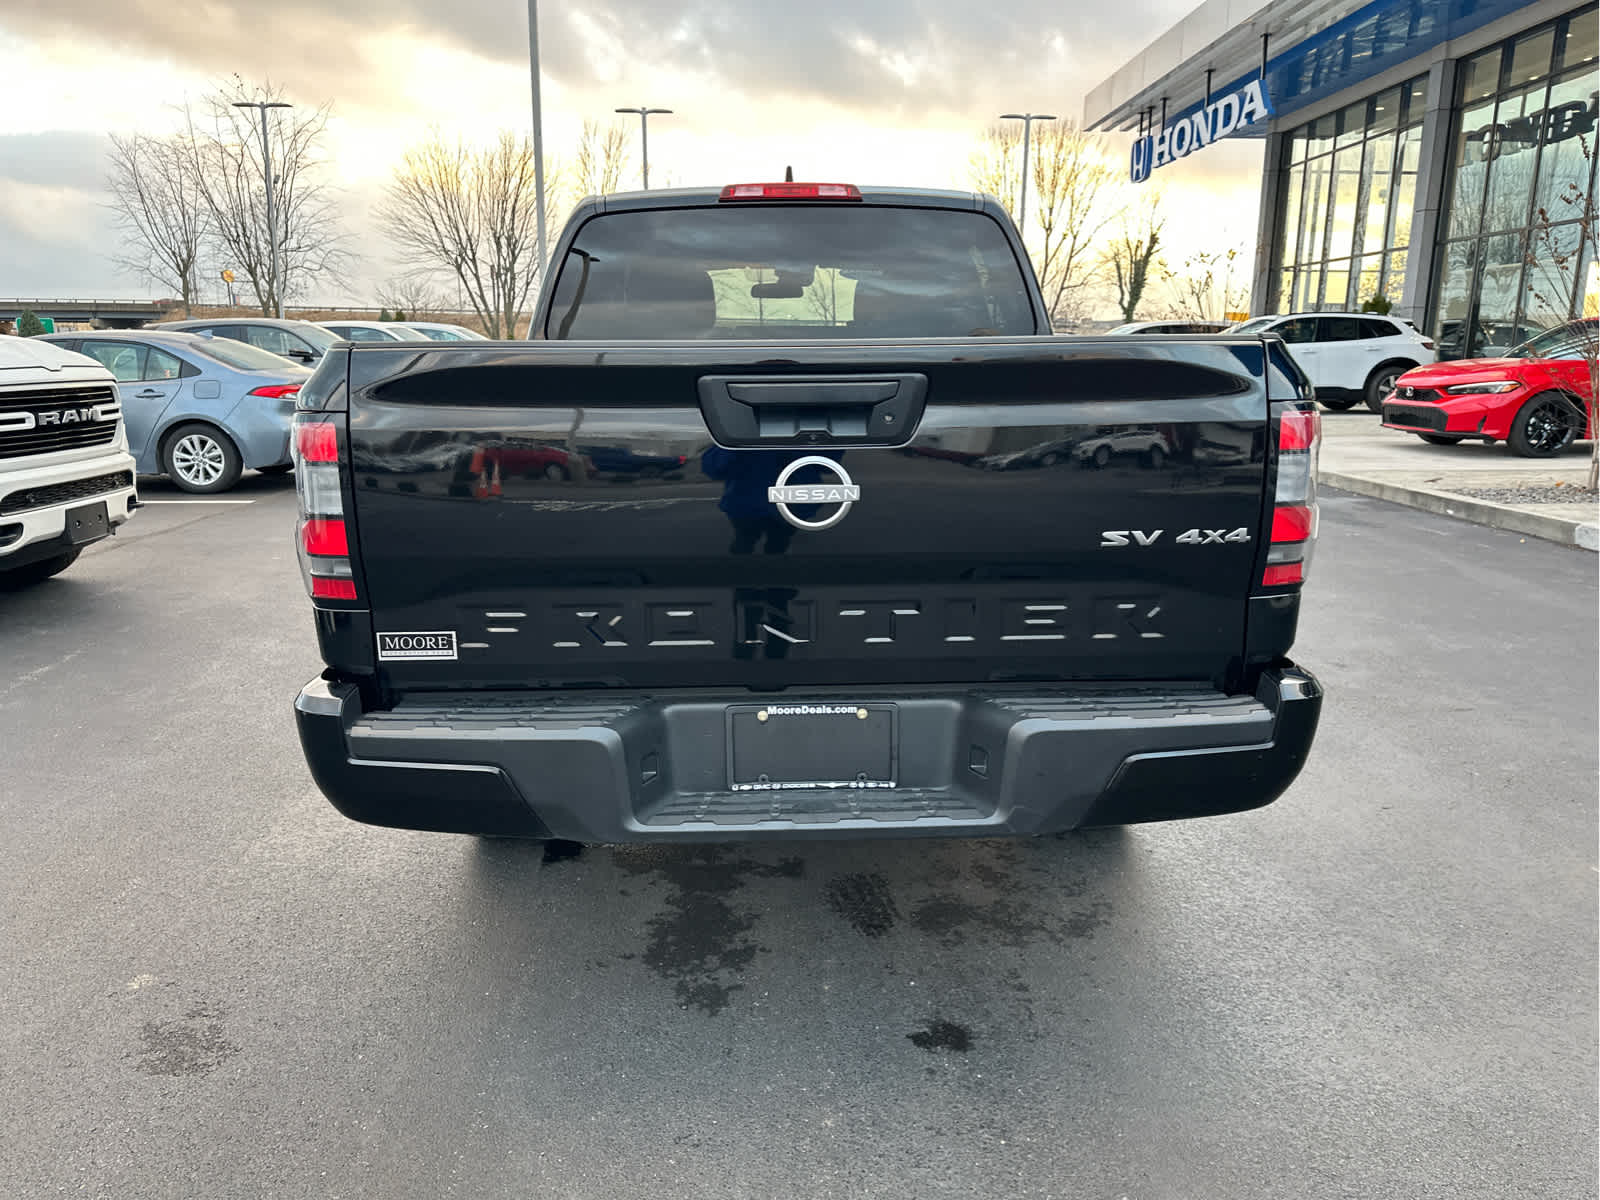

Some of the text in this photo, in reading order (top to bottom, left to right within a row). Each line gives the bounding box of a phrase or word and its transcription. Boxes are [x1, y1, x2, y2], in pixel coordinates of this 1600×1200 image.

[1152, 80, 1270, 168] HONDA
[38, 408, 99, 425] RAM
[771, 488, 858, 501] NISSAN
[1100, 527, 1251, 547] SV 4x4
[384, 636, 449, 649] MOORE
[767, 705, 857, 715] MooreDeals.com
